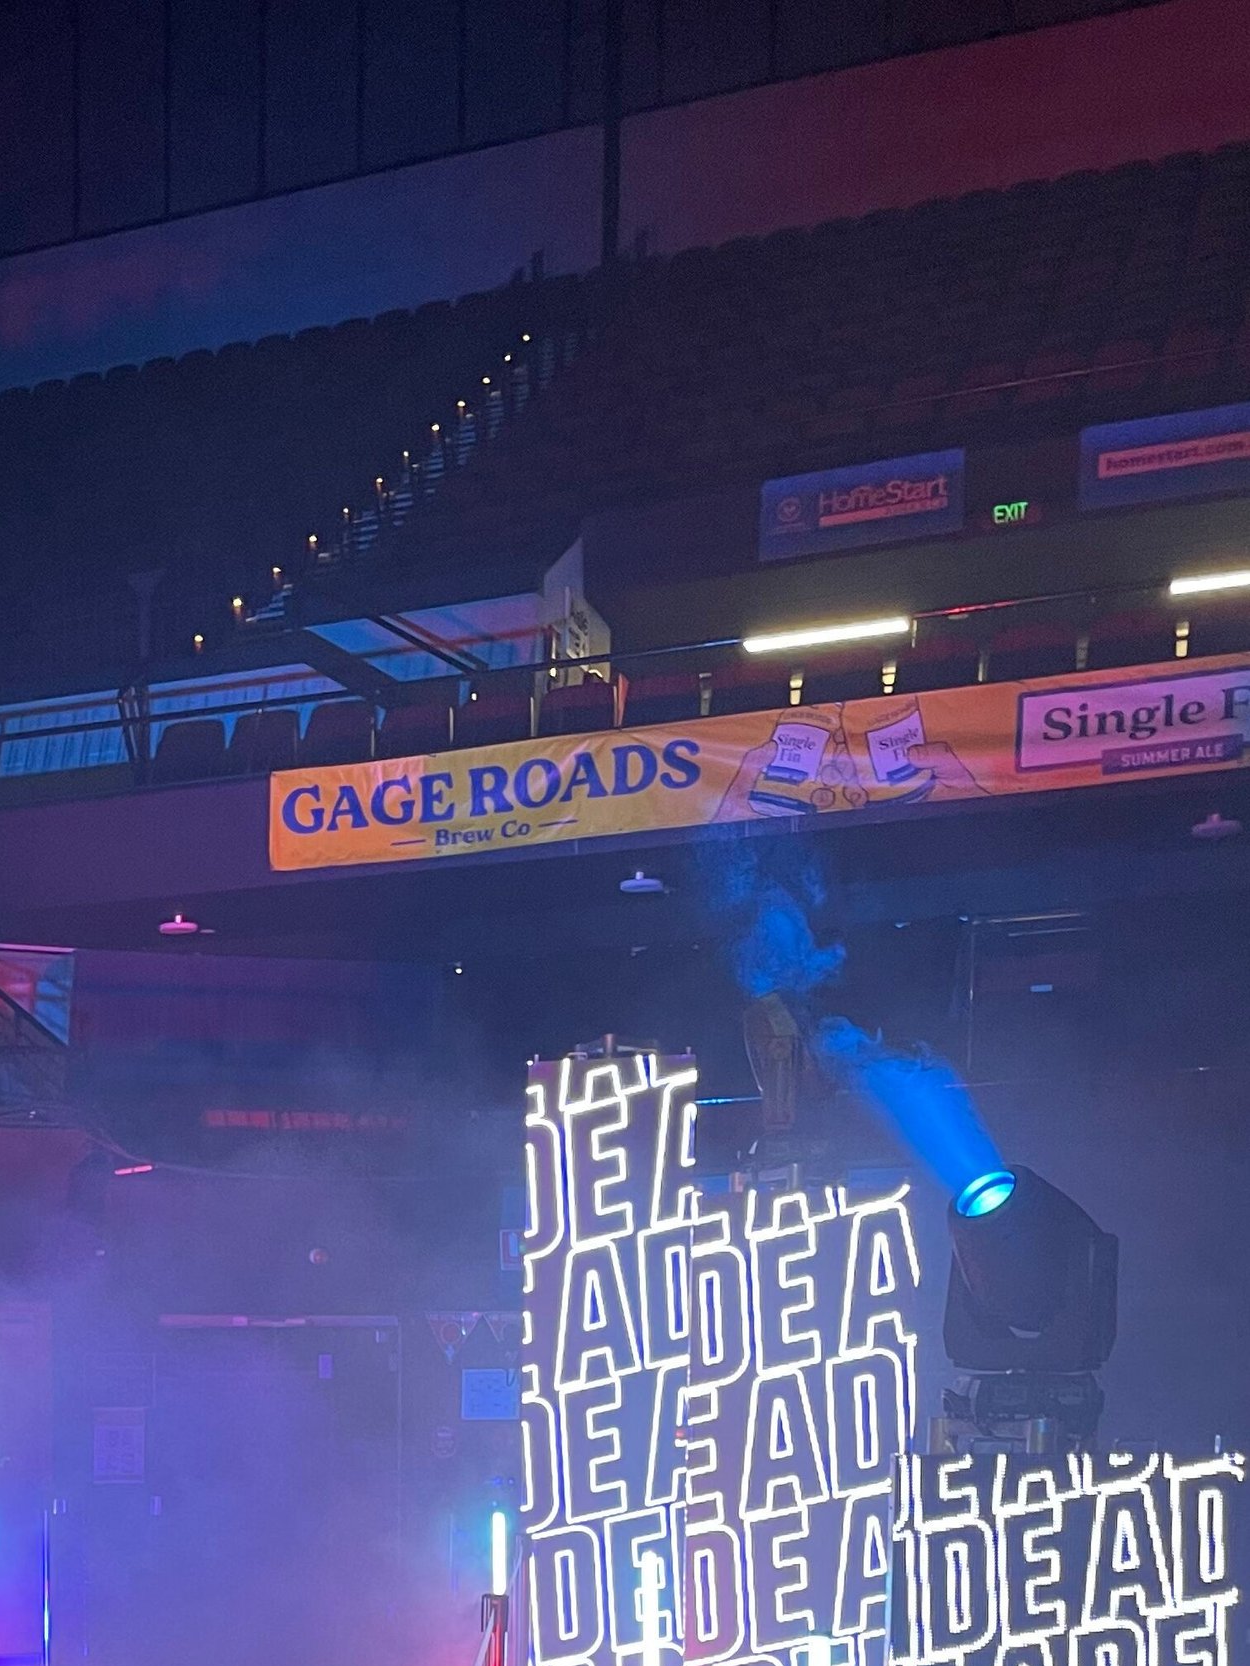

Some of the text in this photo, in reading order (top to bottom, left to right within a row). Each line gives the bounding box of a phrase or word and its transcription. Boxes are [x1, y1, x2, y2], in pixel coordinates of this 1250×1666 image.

[818, 474, 948, 514] HomeStart
[993, 501, 1028, 524] EXIT
[1042, 694, 1207, 741] Single
[777, 733, 816, 751] Single
[878, 727, 919, 751] Single
[779, 747, 801, 763] Fin
[1121, 743, 1223, 767] SUMMER ALE
[281, 739, 702, 835] GAGE ROADS
[434, 820, 532, 848] Brew Co
